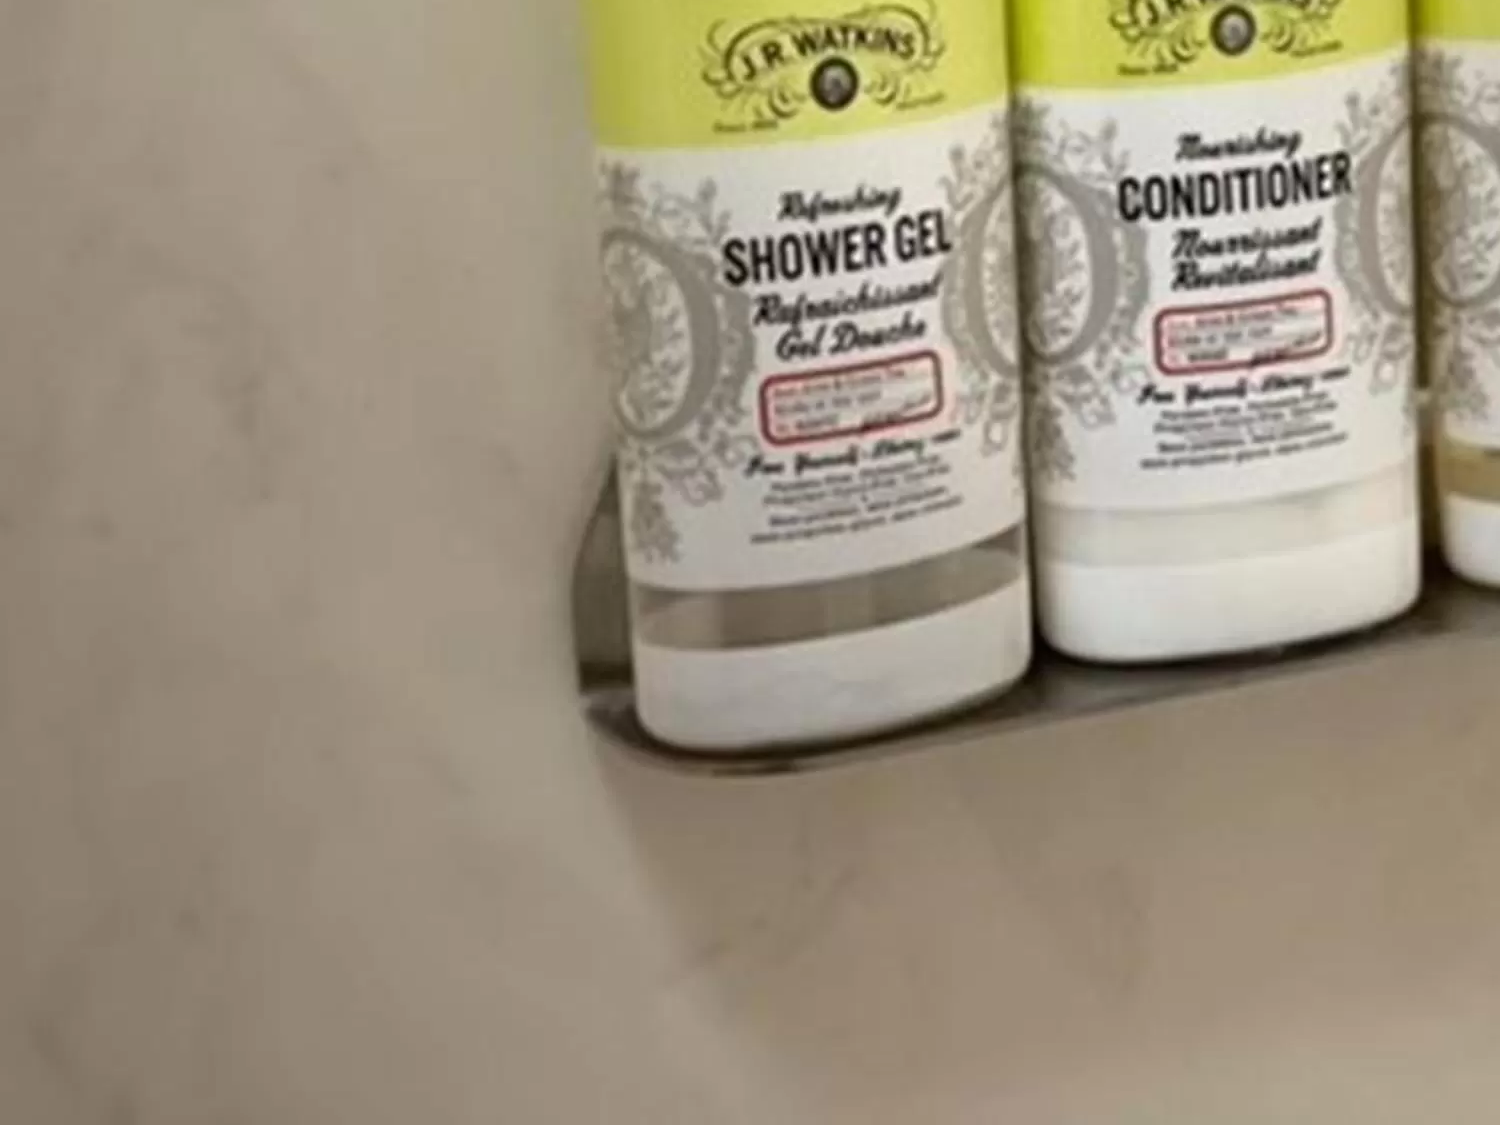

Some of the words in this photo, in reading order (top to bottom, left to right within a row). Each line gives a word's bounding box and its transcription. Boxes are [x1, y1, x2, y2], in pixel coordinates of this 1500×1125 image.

[790, 25, 916, 62] WATKINS
[1118, 150, 1353, 223] CONDITIONER
[721, 221, 888, 288] SHOWER
[894, 206, 953, 263] GEL
[775, 324, 827, 362] Gel
